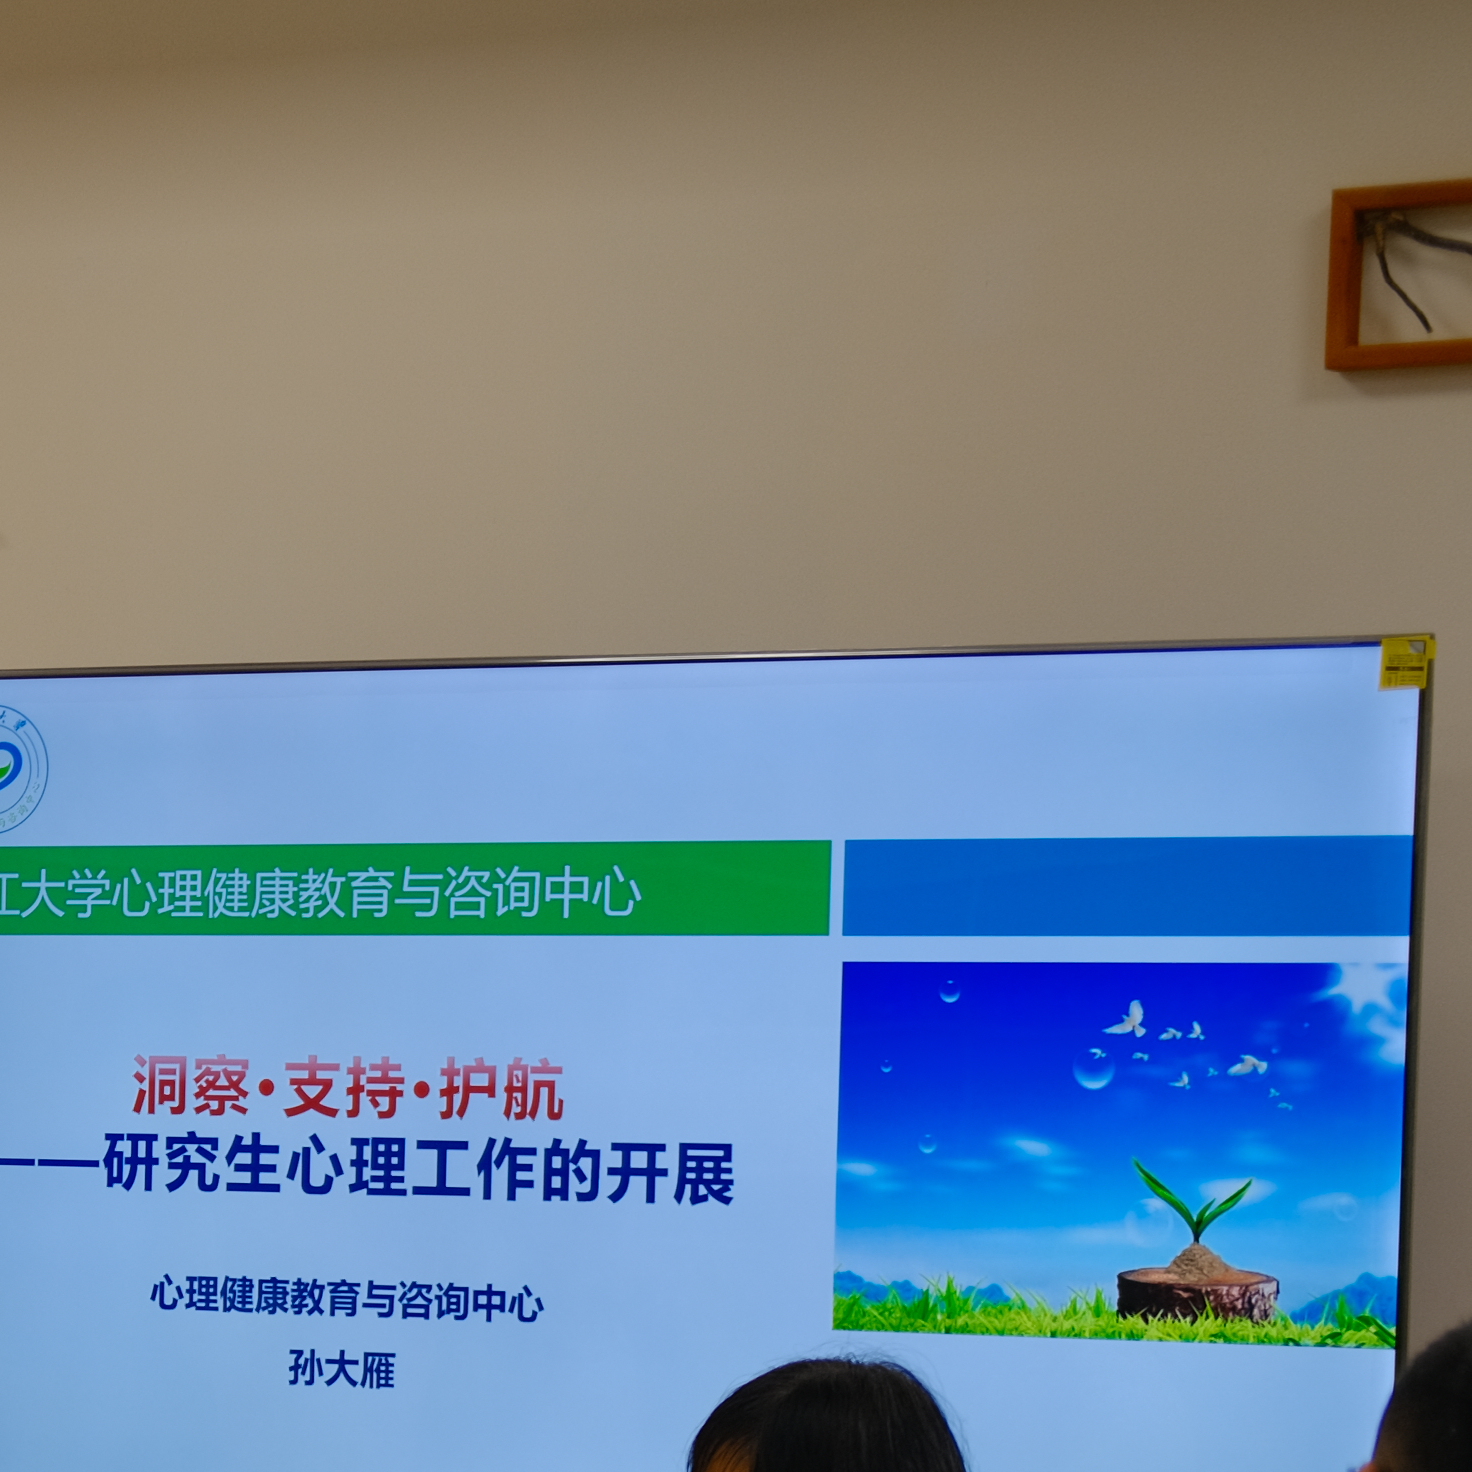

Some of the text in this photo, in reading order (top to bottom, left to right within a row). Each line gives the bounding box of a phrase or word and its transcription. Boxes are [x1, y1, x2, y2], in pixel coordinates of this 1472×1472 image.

[133, 1053, 565, 1123] 洞察·支持·护航
[149, 1274, 545, 1325] 心理健康教育与咨询中心
[287, 1348, 397, 1390] 孙大雁
